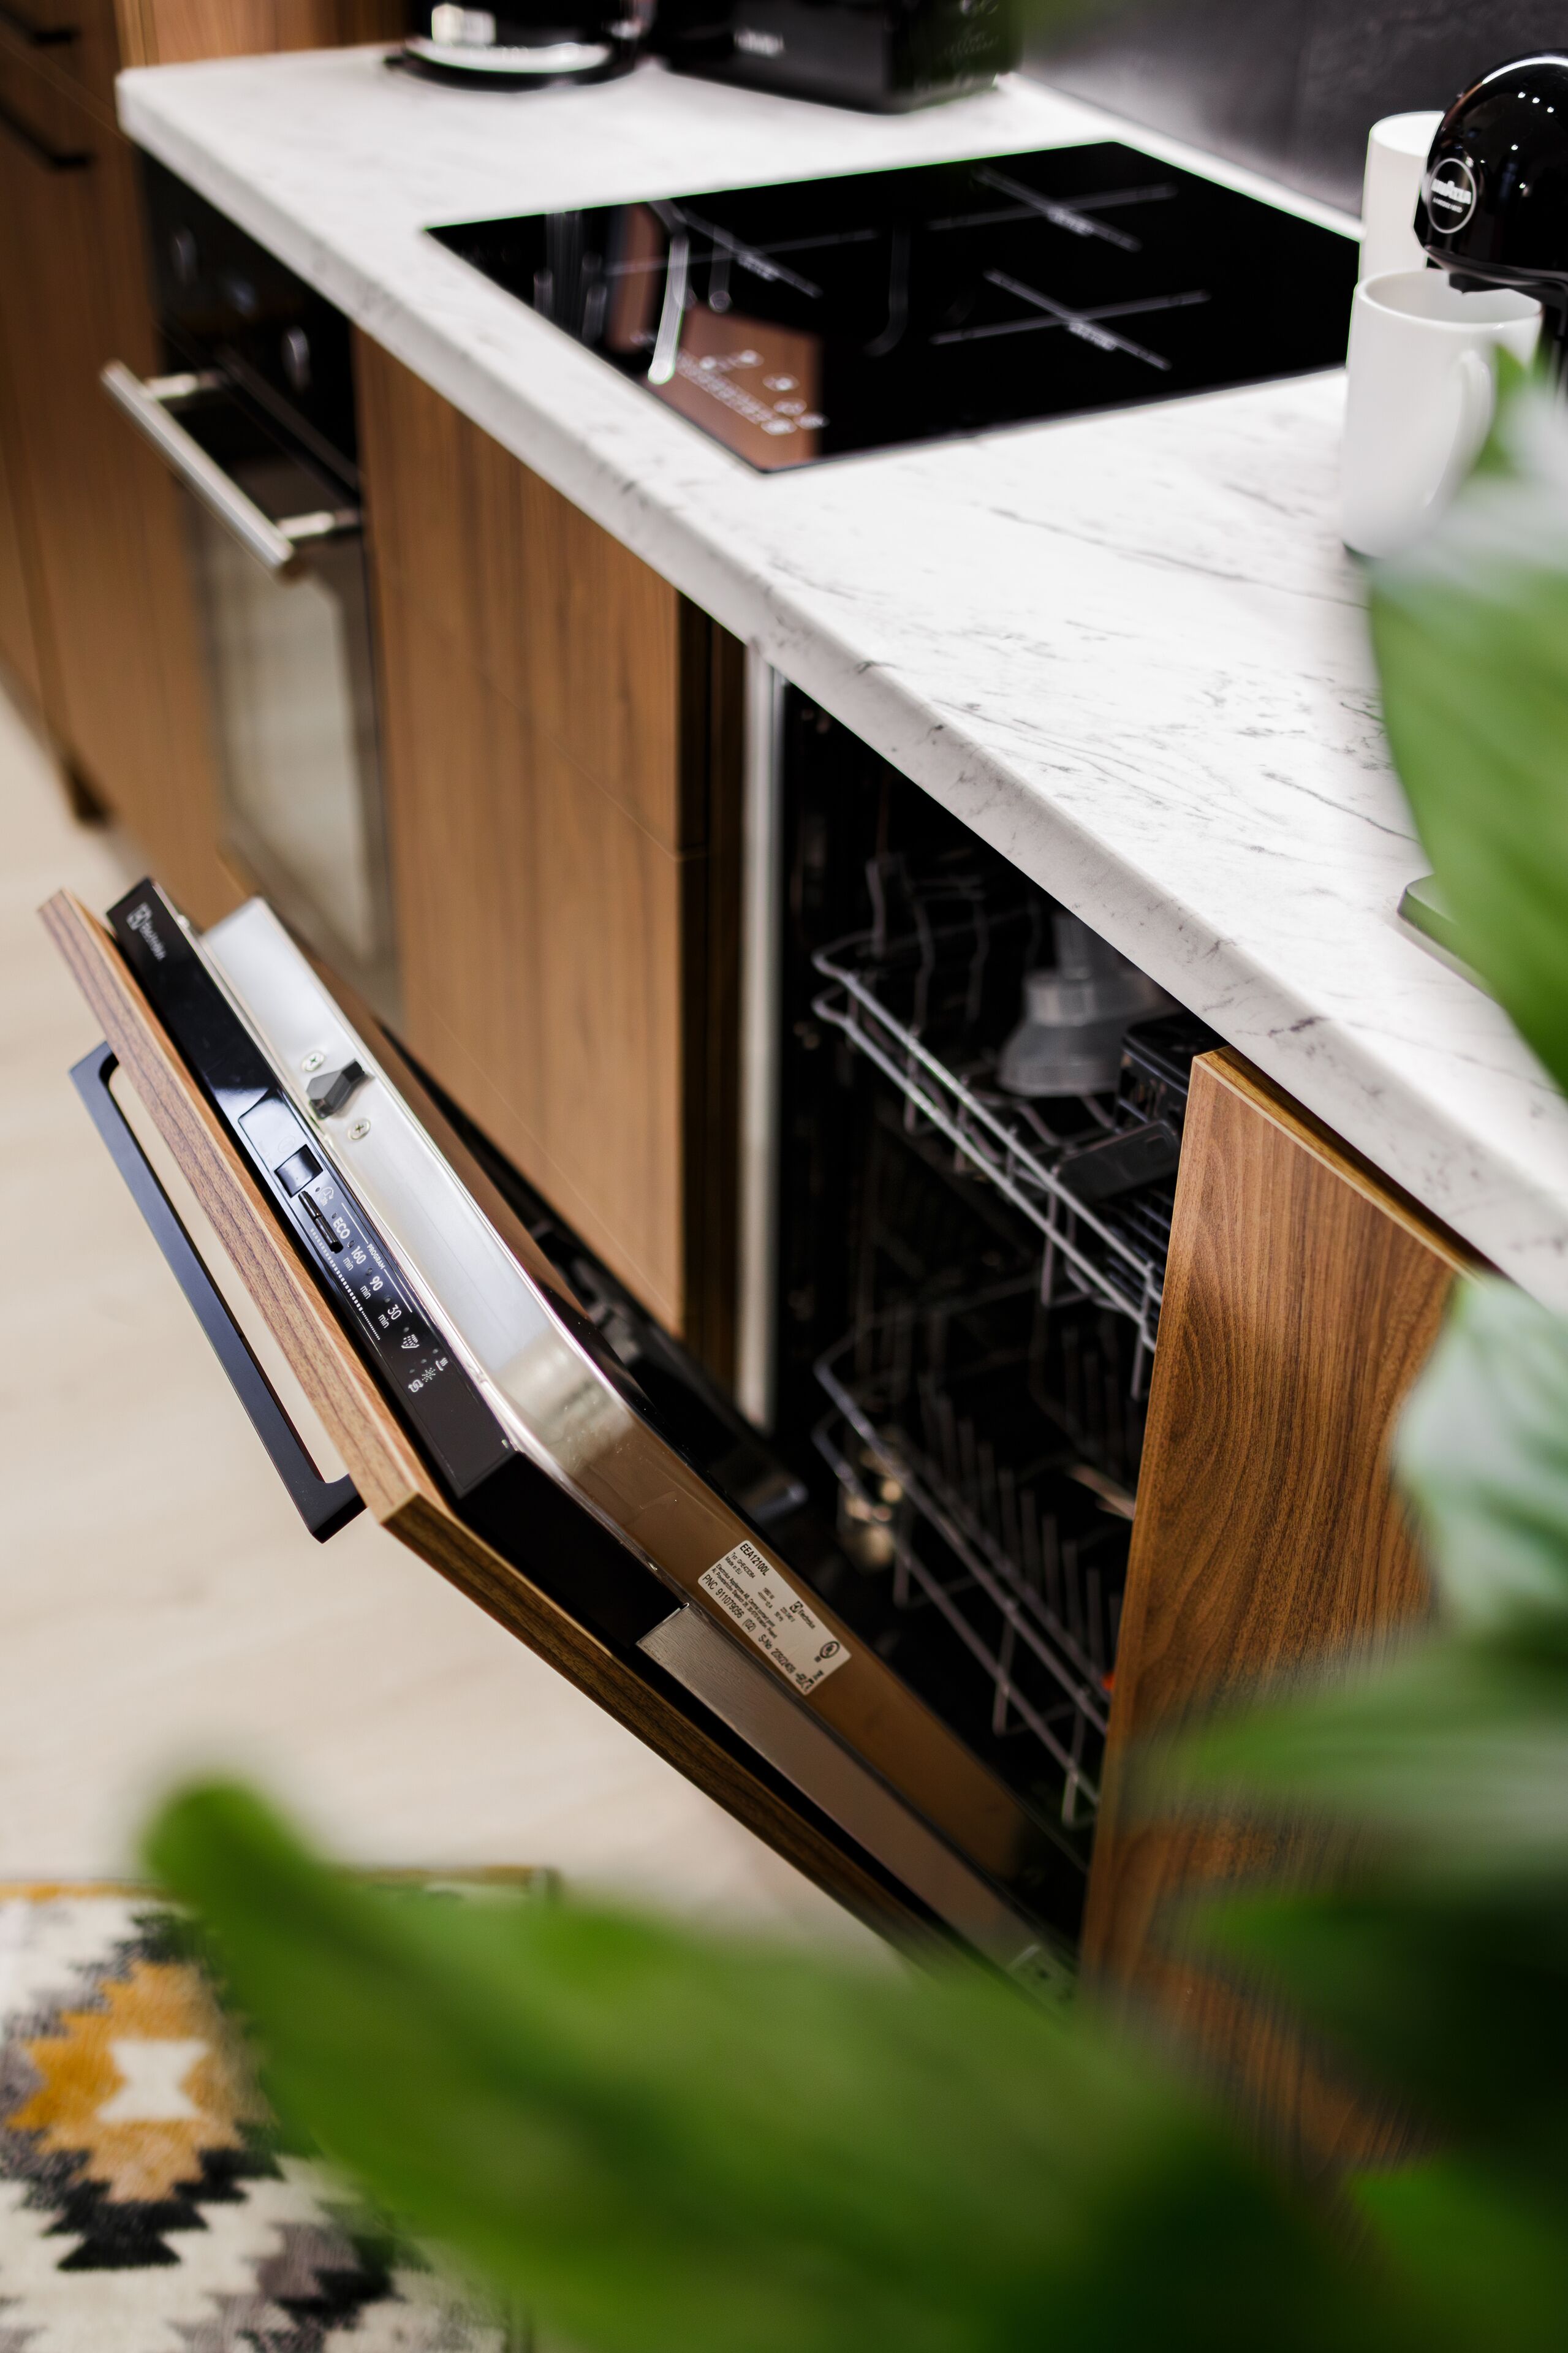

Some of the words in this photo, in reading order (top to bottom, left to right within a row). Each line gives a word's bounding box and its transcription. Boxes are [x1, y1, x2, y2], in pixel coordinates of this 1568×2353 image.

[333, 1217, 350, 1239] ECO
[351, 1246, 366, 1264] 160
[367, 1243, 386, 1270] PROGRAM
[343, 1257, 354, 1271] min
[369, 1276, 384, 1291] 90
[360, 1286, 371, 1299] min
[387, 1304, 402, 1320] 30
[378, 1314, 389, 1328] min
[740, 1543, 770, 1576] EEA12100L
[702, 1574, 718, 1590] PNC
[715, 1588, 744, 1618] 911079056
